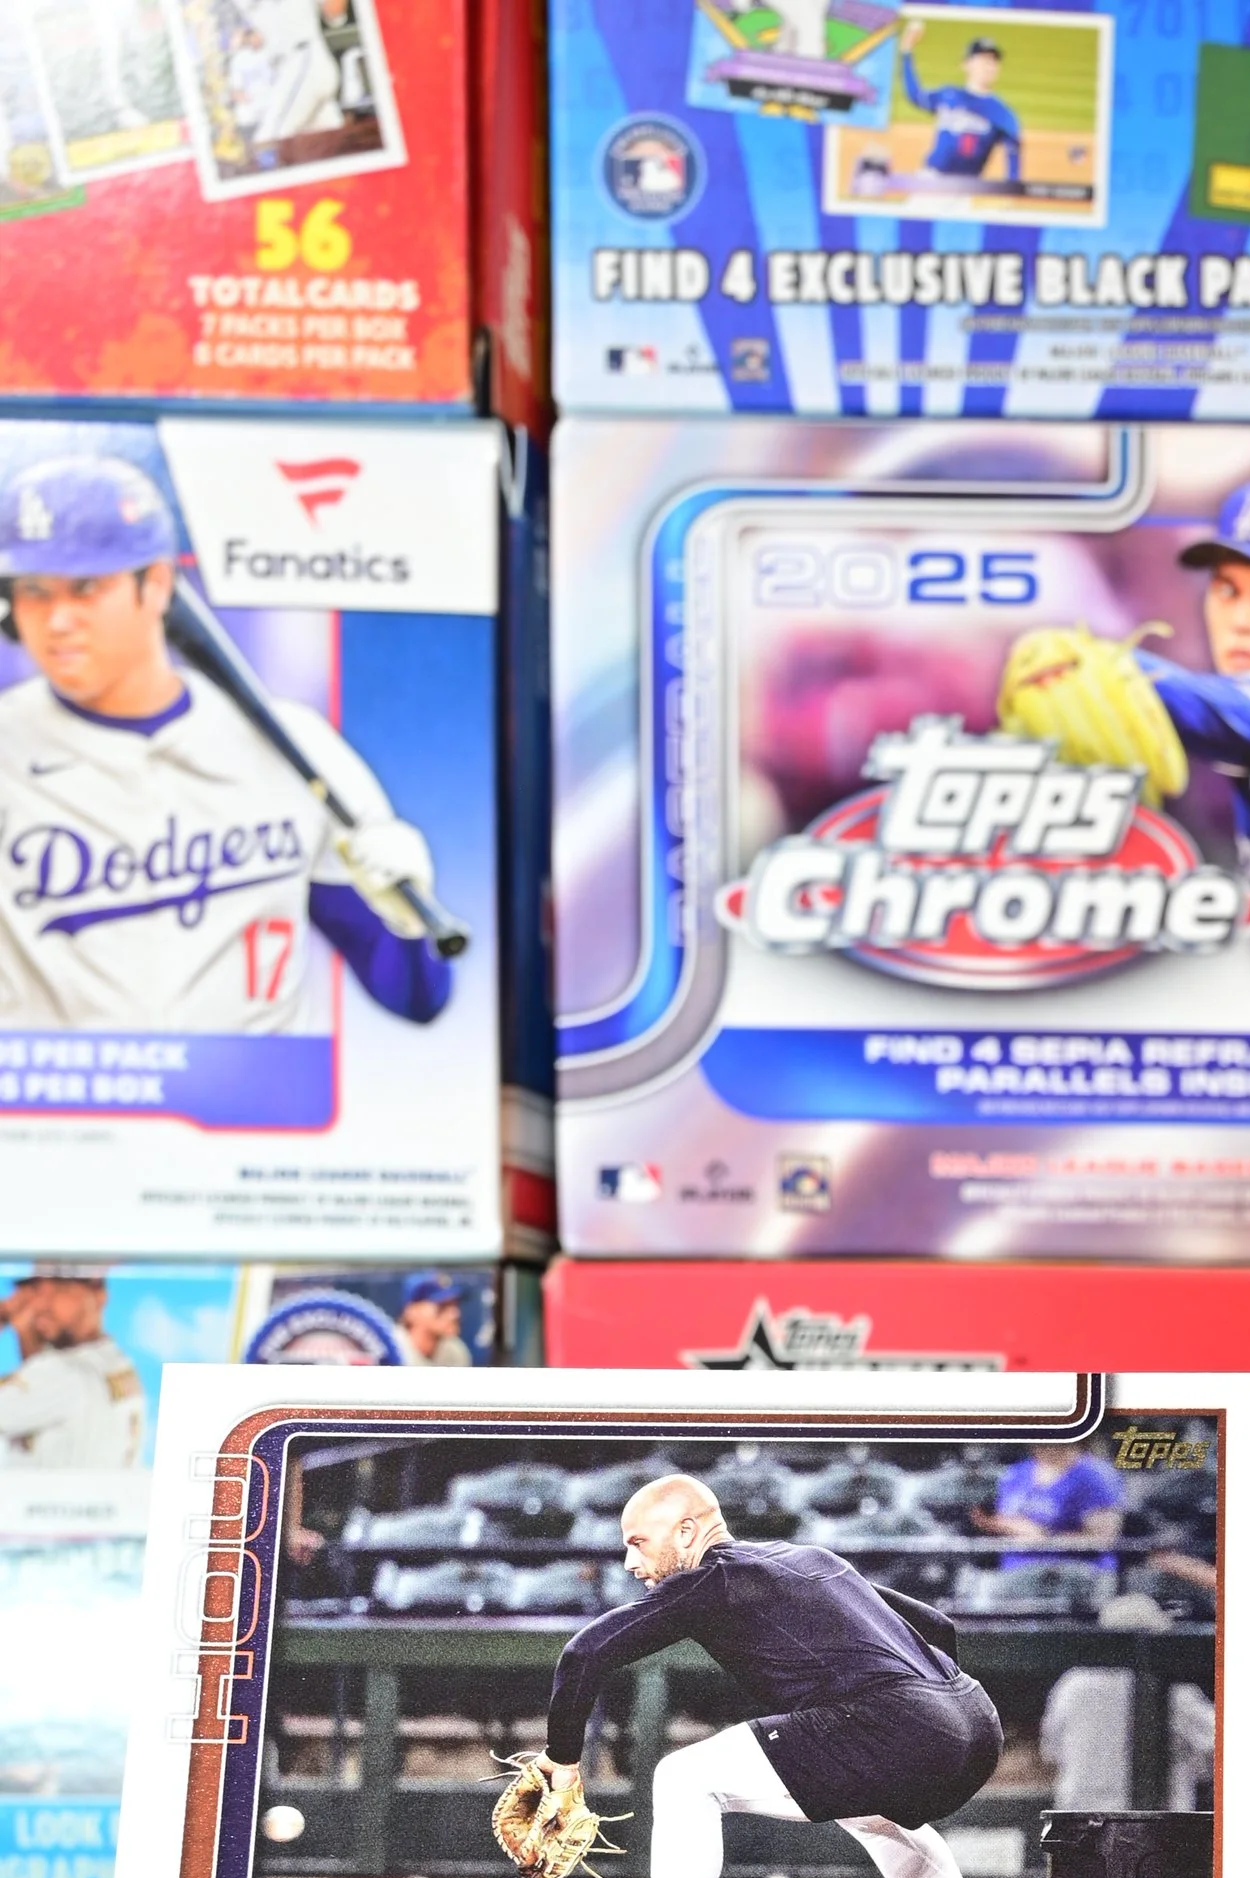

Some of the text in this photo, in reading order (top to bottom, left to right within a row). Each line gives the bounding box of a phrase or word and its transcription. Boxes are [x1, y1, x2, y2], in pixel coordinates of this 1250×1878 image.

[257, 198, 352, 271] 56
[187, 275, 420, 310] TOTAL CARDS
[593, 248, 709, 303] FIND
[720, 248, 758, 304] 4
[768, 251, 1023, 305] EXCLUSIVE
[1035, 253, 1187, 308] BLACK
[200, 312, 409, 341] 7 PACKS PER BOX
[215, 342, 299, 369] CARDS
[301, 343, 347, 370] PER
[353, 345, 417, 371] PACK
[223, 539, 411, 585] Fanatics
[755, 545, 1038, 608] 2025
[864, 716, 1142, 857] Topps
[10, 815, 305, 929] Dodgers
[752, 848, 1240, 945] Chrome
[243, 919, 293, 1001] 17
[32, 1038, 95, 1070] PER
[101, 1039, 189, 1071] PACK
[863, 1034, 964, 1065] FIND
[970, 1036, 1002, 1065] 4
[1009, 1036, 1135, 1068] SEPIA
[24, 1073, 87, 1103] PER
[91, 1073, 165, 1104] BOX
[935, 1065, 1173, 1098] PARALLELS
[1112, 1425, 1210, 1470] Topps
[15, 1810, 102, 1849] LOOK
